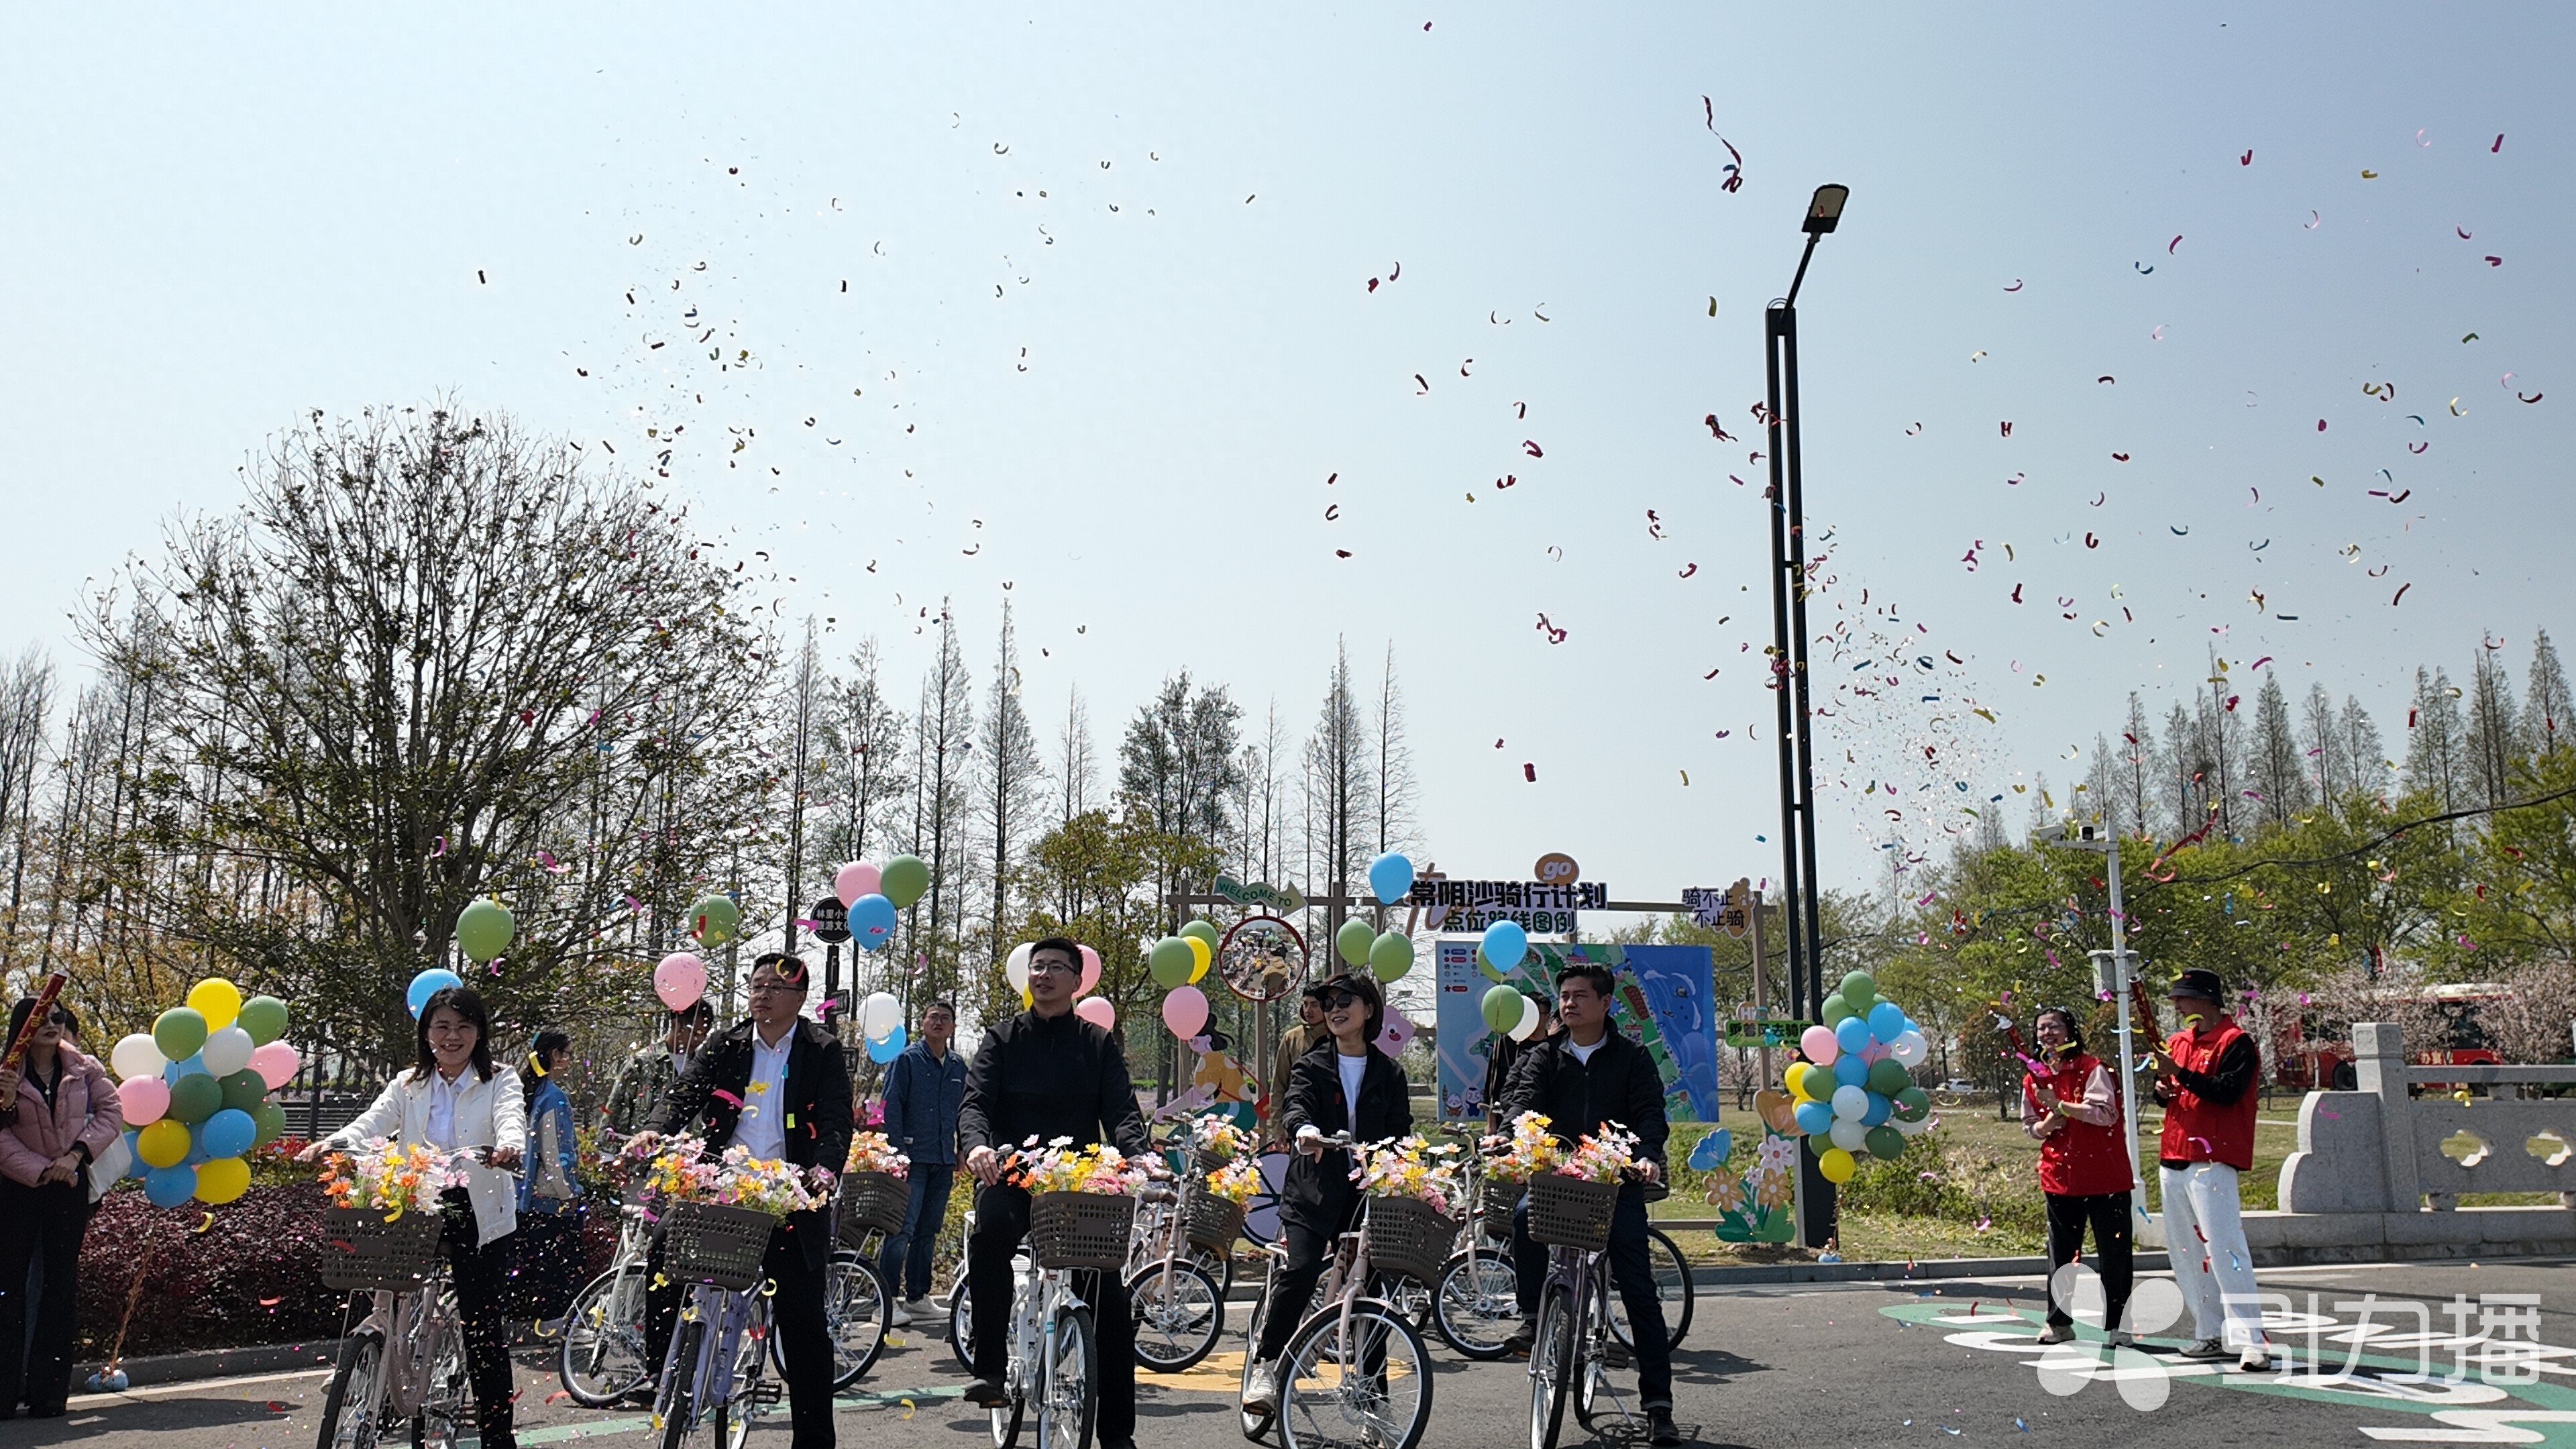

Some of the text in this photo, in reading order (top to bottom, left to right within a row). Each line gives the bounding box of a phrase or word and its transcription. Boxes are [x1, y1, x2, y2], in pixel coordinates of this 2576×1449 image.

[1544, 861, 1572, 879] go
[1218, 882, 1292, 907] WELCOME TO
[1409, 880, 1607, 909] 常阴沙骑行计划
[1682, 888, 1735, 908] 骑不止
[1694, 909, 1745, 928] 不止骑
